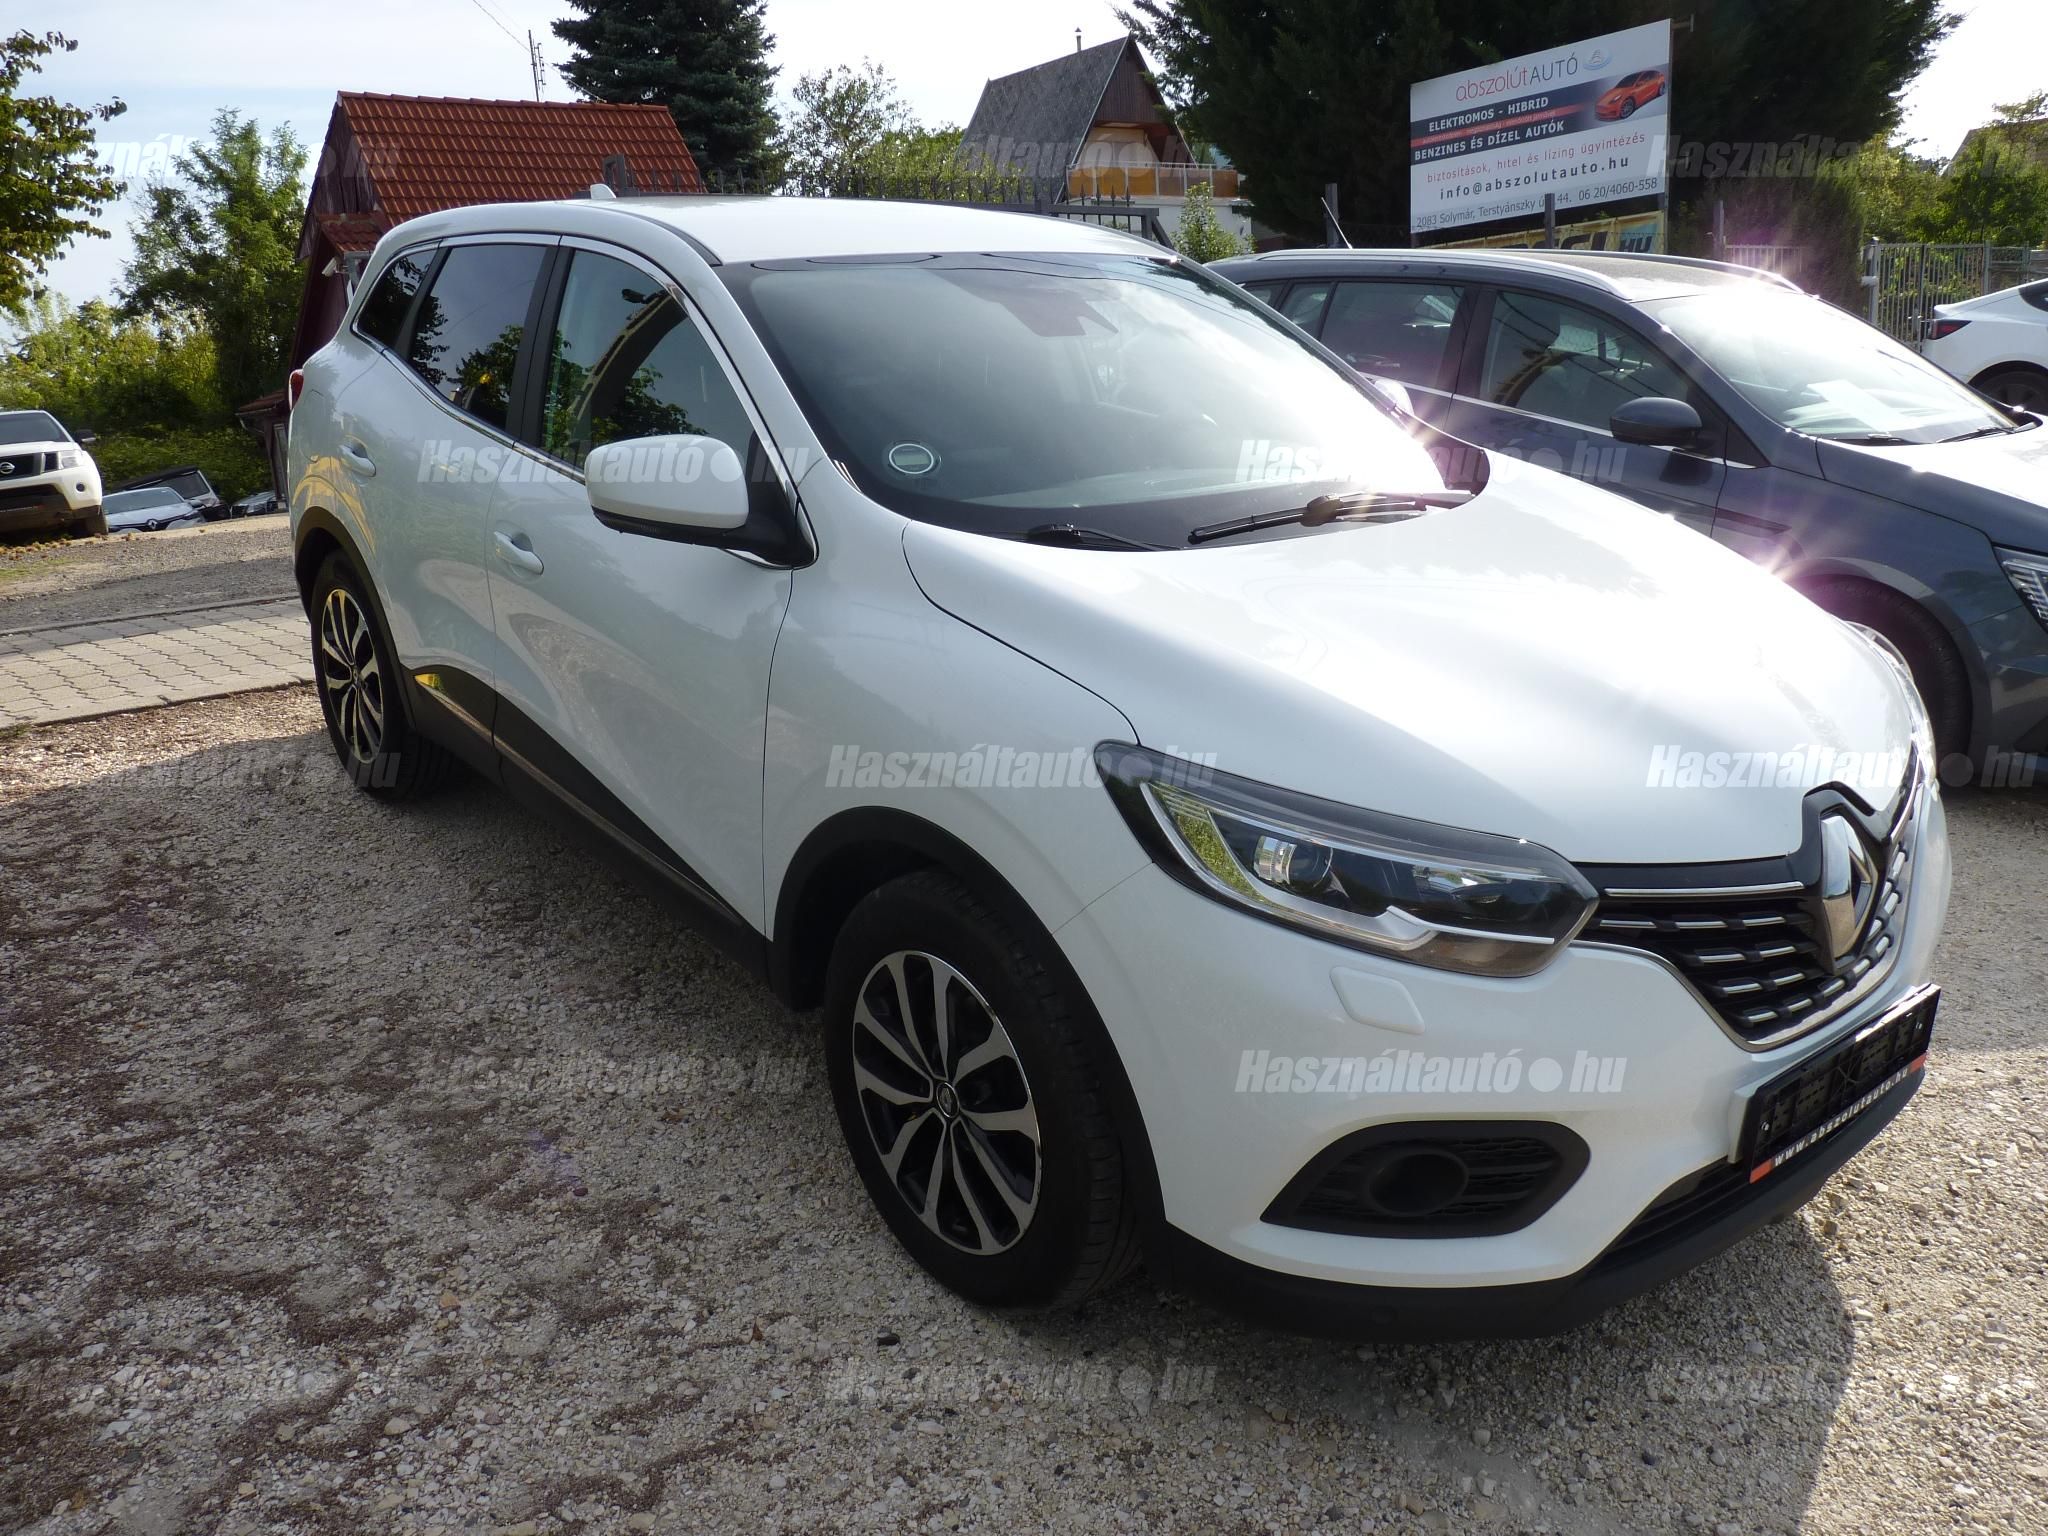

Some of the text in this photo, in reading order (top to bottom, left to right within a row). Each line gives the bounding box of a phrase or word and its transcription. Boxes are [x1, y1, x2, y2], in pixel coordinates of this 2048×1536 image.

[1429, 108, 1495, 132] ELEKTROMOS
[1508, 97, 1549, 115] HIBRID
[1414, 141, 1466, 161] BENZINES
[1470, 135, 1483, 150] ÉS
[1487, 130, 1521, 146] DÍZEL
[1525, 119, 1565, 139] AUTÓK
[1497, 156, 1521, 170] hitel
[1527, 152, 1539, 164] és
[1440, 157, 1628, 200] info@abszolutauto.hu
[1416, 214, 1437, 228] 2083
[1440, 208, 1475, 224] Solymár,
[1479, 199, 1535, 217] Terstyánszky
[1578, 188, 1591, 201] 06
[1593, 177, 1658, 200] 20/4060-558
[1775, 1068, 1908, 1167] www.abszolutauto.hu
